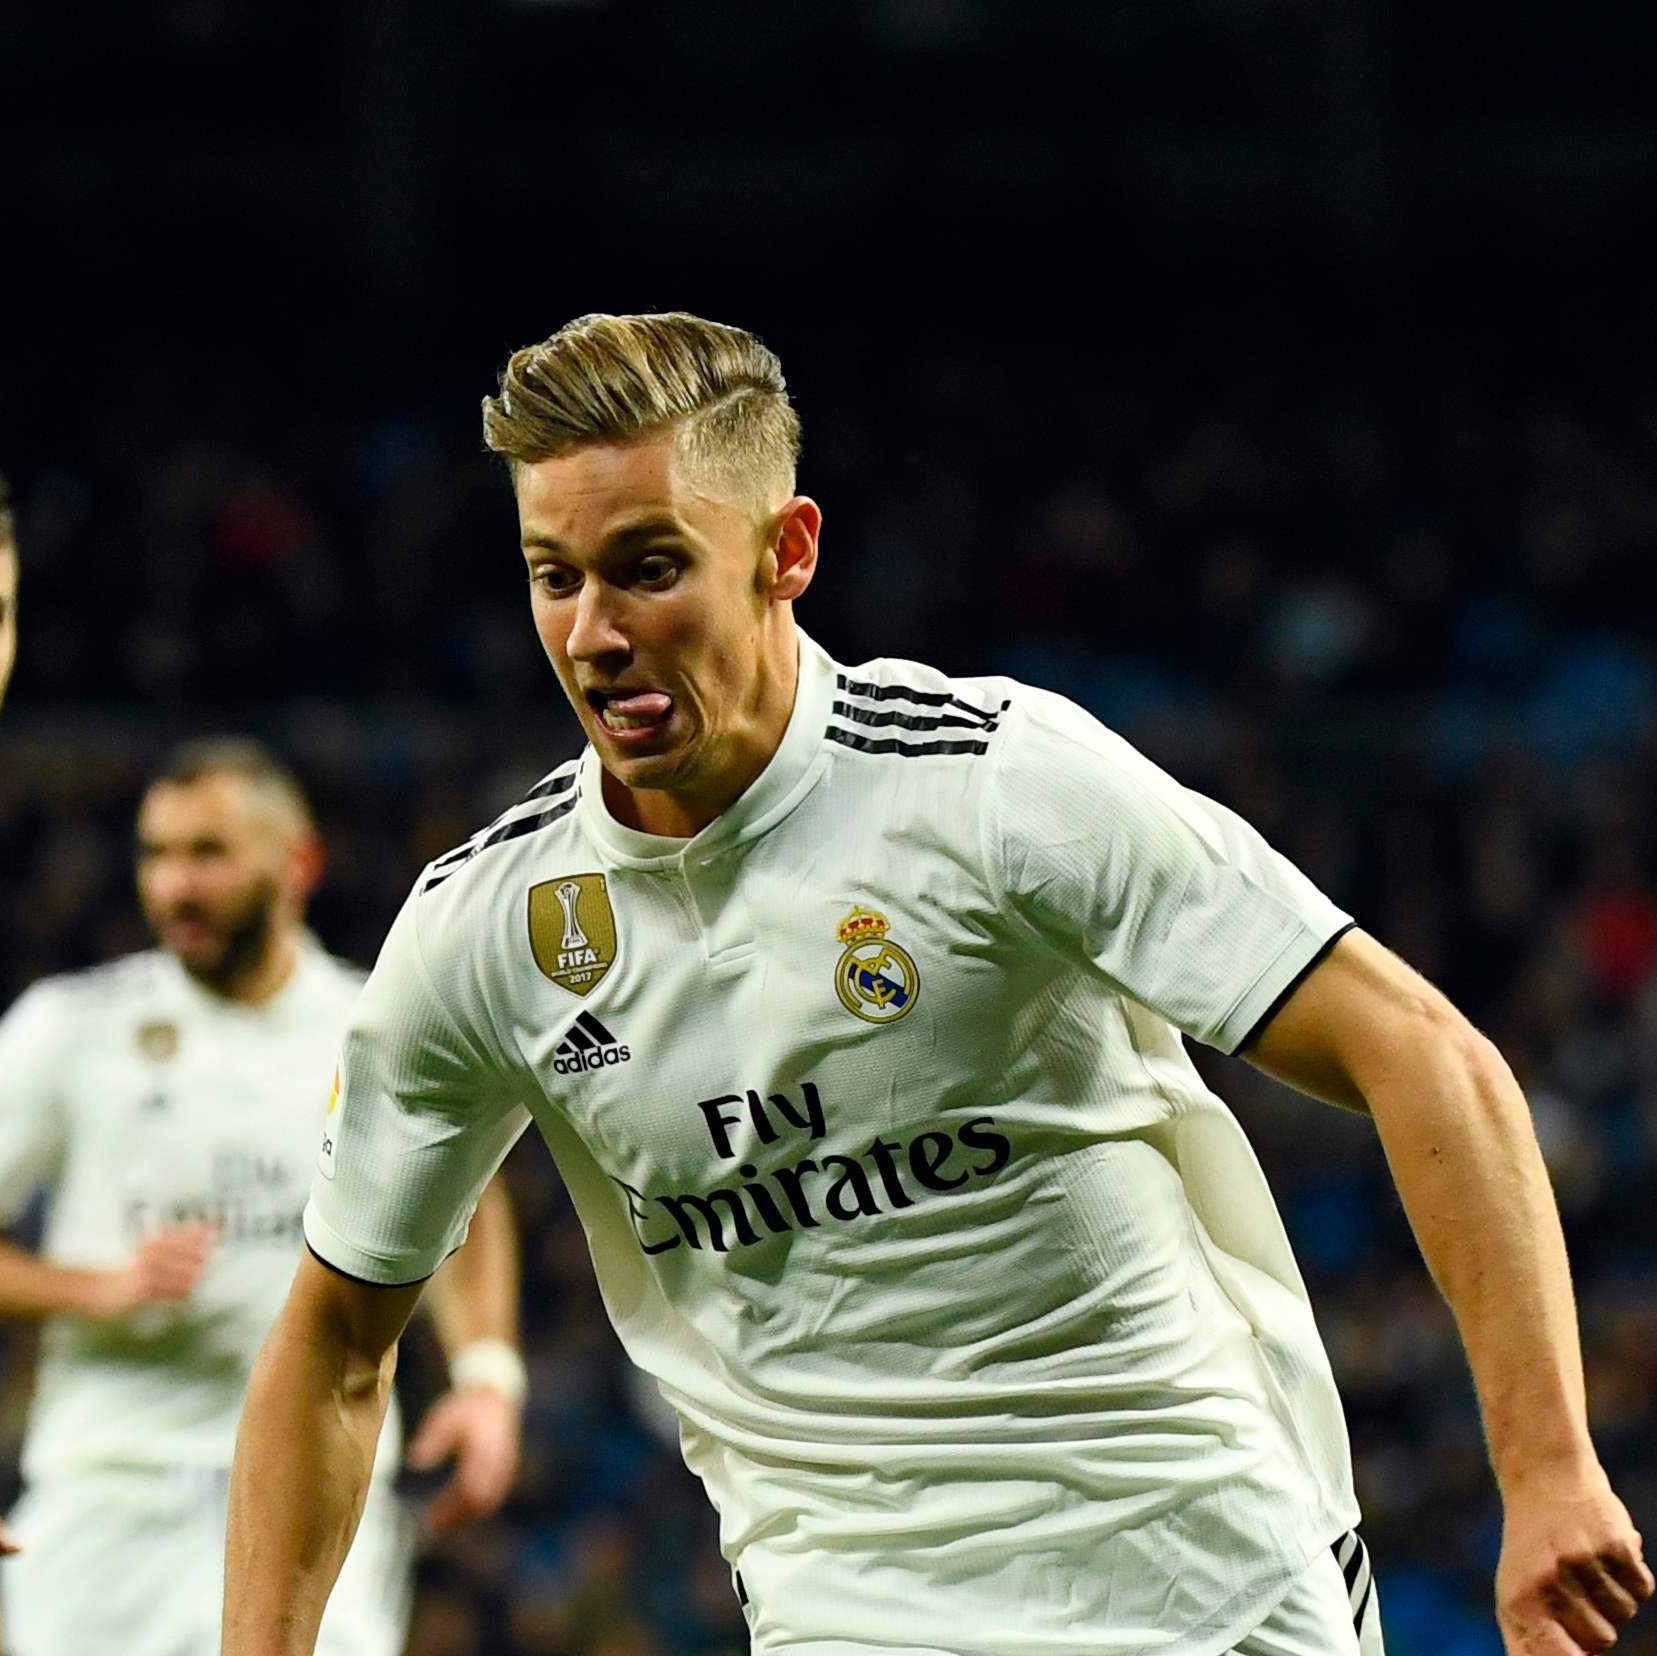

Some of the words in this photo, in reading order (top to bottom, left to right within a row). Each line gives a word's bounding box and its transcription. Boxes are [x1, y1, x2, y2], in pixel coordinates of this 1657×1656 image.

[557, 948, 597, 969] FIFA
[567, 970, 592, 985] 2017
[553, 1045, 631, 1075] adidas
[697, 1082, 827, 1159] Fly
[610, 1116, 1011, 1255] Emirates
